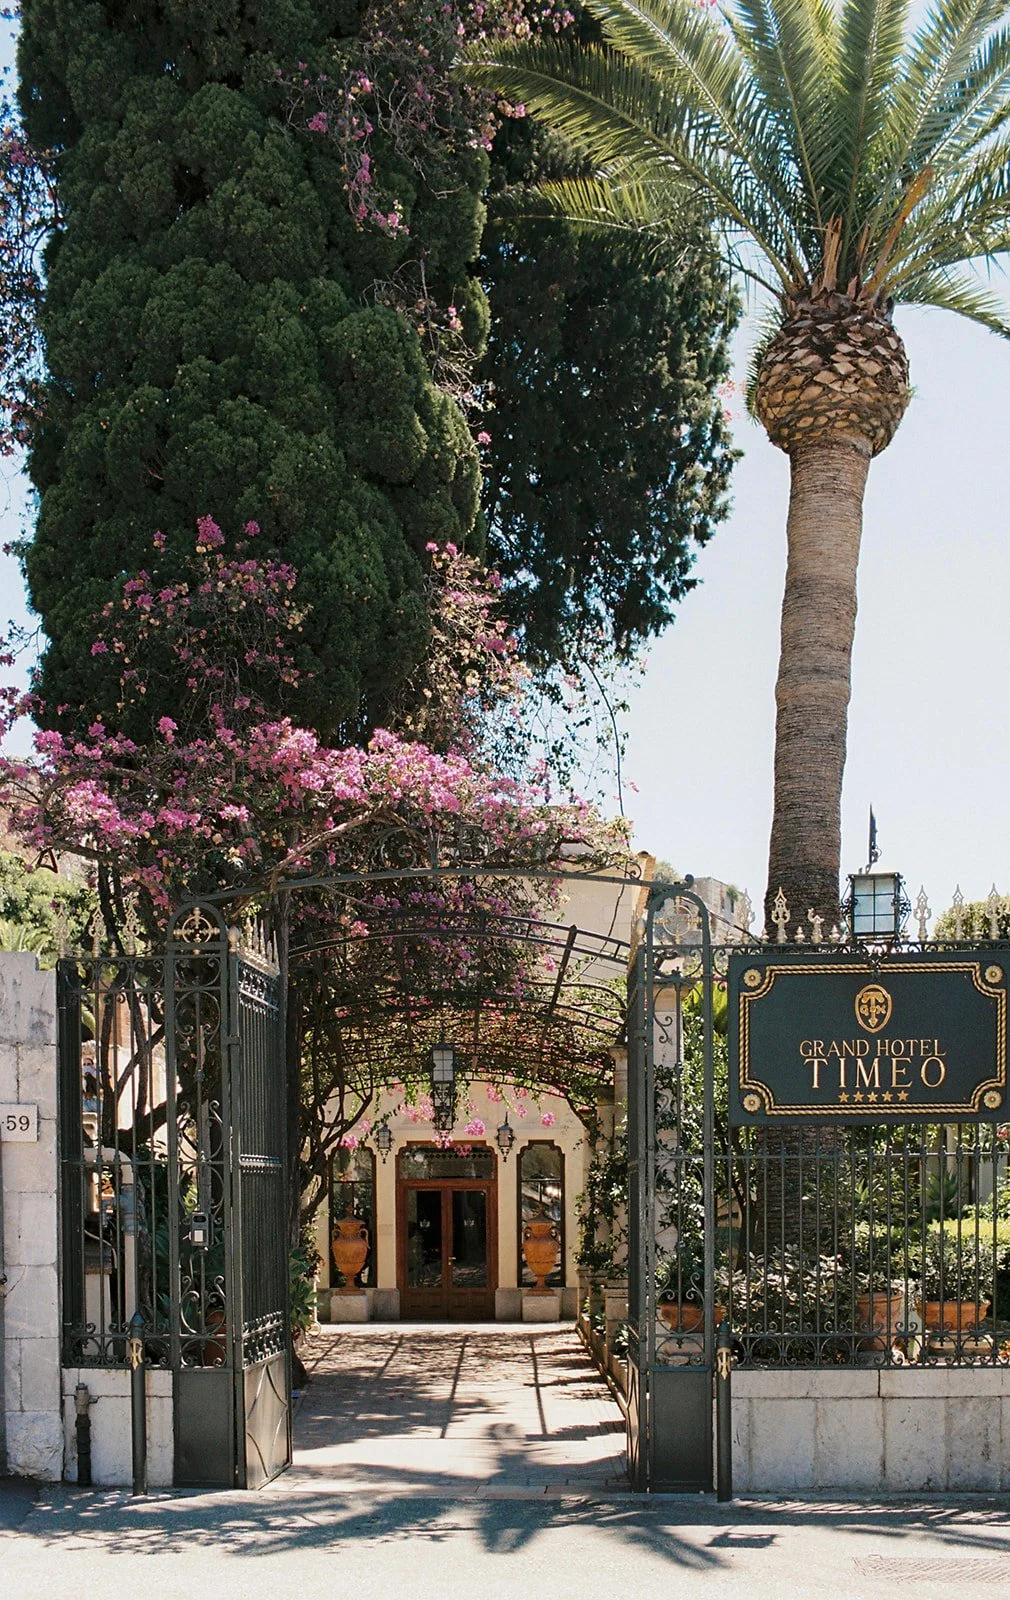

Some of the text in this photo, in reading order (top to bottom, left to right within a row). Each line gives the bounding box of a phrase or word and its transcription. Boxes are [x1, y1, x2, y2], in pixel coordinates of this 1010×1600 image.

[799, 1039, 946, 1057] GRAND HOTEL
[803, 1056, 946, 1089] TIMEO
[6, 1115, 30, 1132] 59
